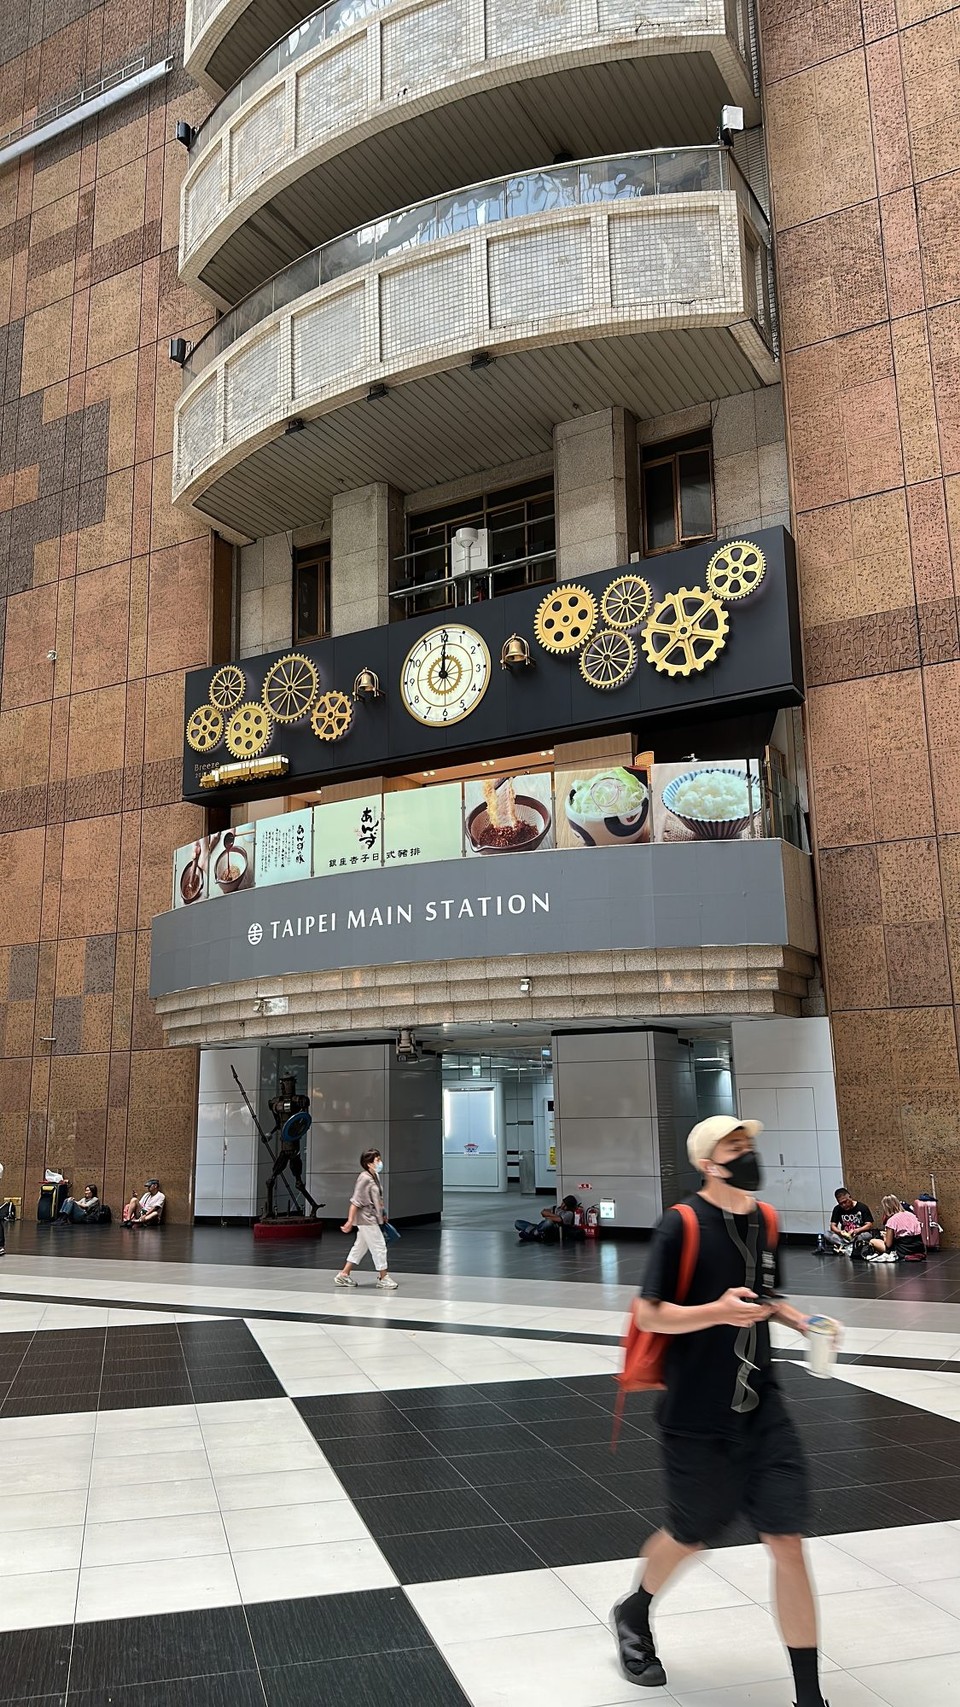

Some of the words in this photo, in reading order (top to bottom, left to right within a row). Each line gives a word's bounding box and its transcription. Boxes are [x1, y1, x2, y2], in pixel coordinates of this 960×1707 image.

[425, 642, 432, 652] 11
[470, 646, 476, 654] 2
[412, 660, 421, 668] 10
[475, 664, 481, 672] 3
[410, 678, 415, 686] 9
[414, 695, 420, 704] 8
[459, 700, 465, 708] 5
[425, 706, 432, 716] 7
[443, 708, 448, 717] 6
[194, 761, 220, 772] Breeze
[270, 912, 337, 940] TAIPEI
[347, 904, 413, 930] MAIN
[425, 892, 551, 922] STATION
